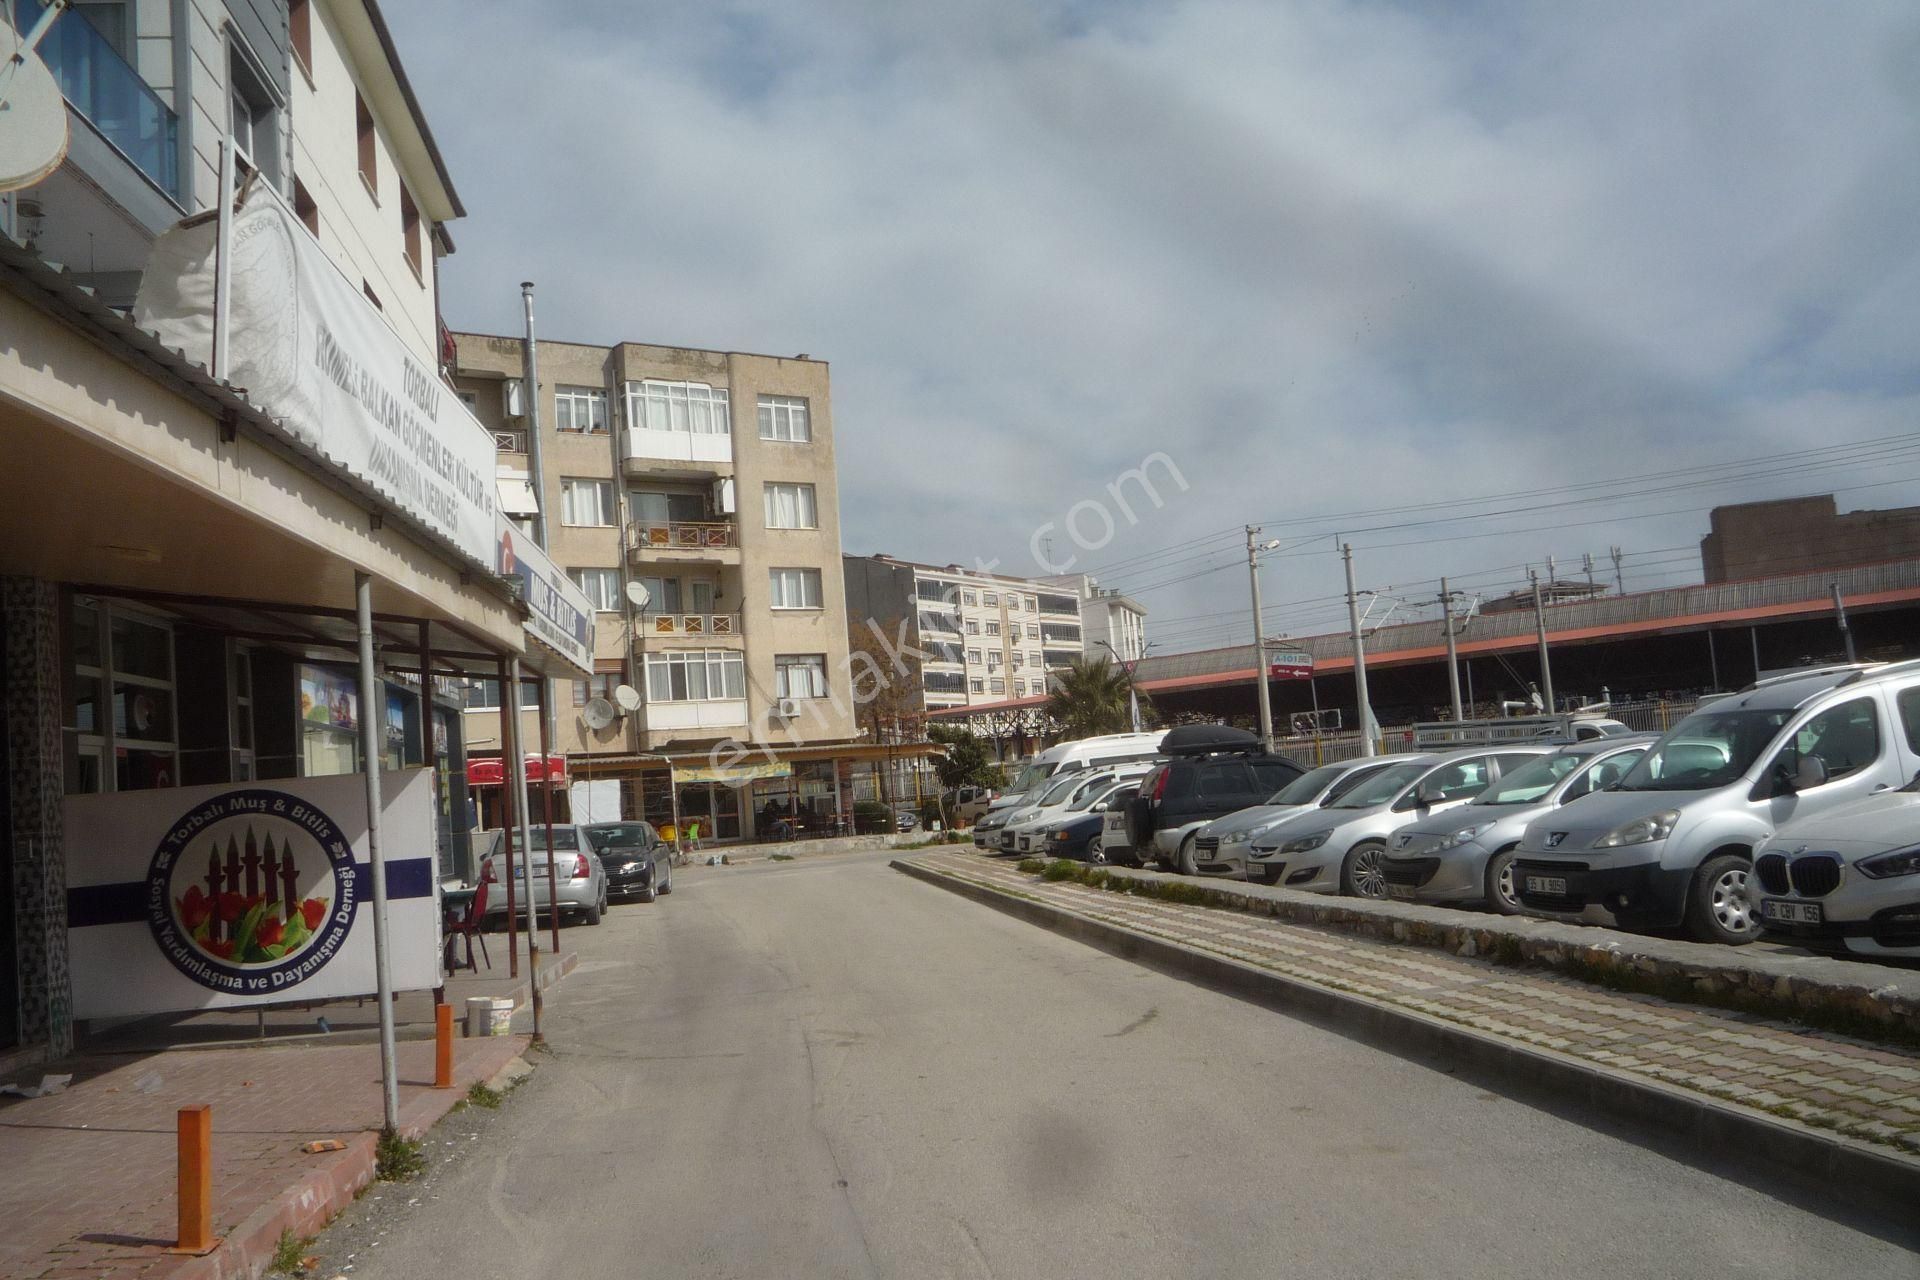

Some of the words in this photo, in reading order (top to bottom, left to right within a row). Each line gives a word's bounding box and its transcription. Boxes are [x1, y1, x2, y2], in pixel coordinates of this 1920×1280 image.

[402, 356, 440, 424] TORBALI
[361, 368, 401, 440] BALKAN
[456, 457, 484, 511] KÜLTÜR
[168, 803, 225, 845] Torbalı
[229, 797, 268, 811] Muş
[273, 799, 287, 811] &
[291, 804, 332, 839] Bitlis
[151, 877, 166, 925] Sosyal
[159, 924, 244, 990] Yardımlaşma
[248, 978, 268, 989] ve
[271, 928, 345, 987] Dayanışma
[336, 866, 356, 925] Derneği
